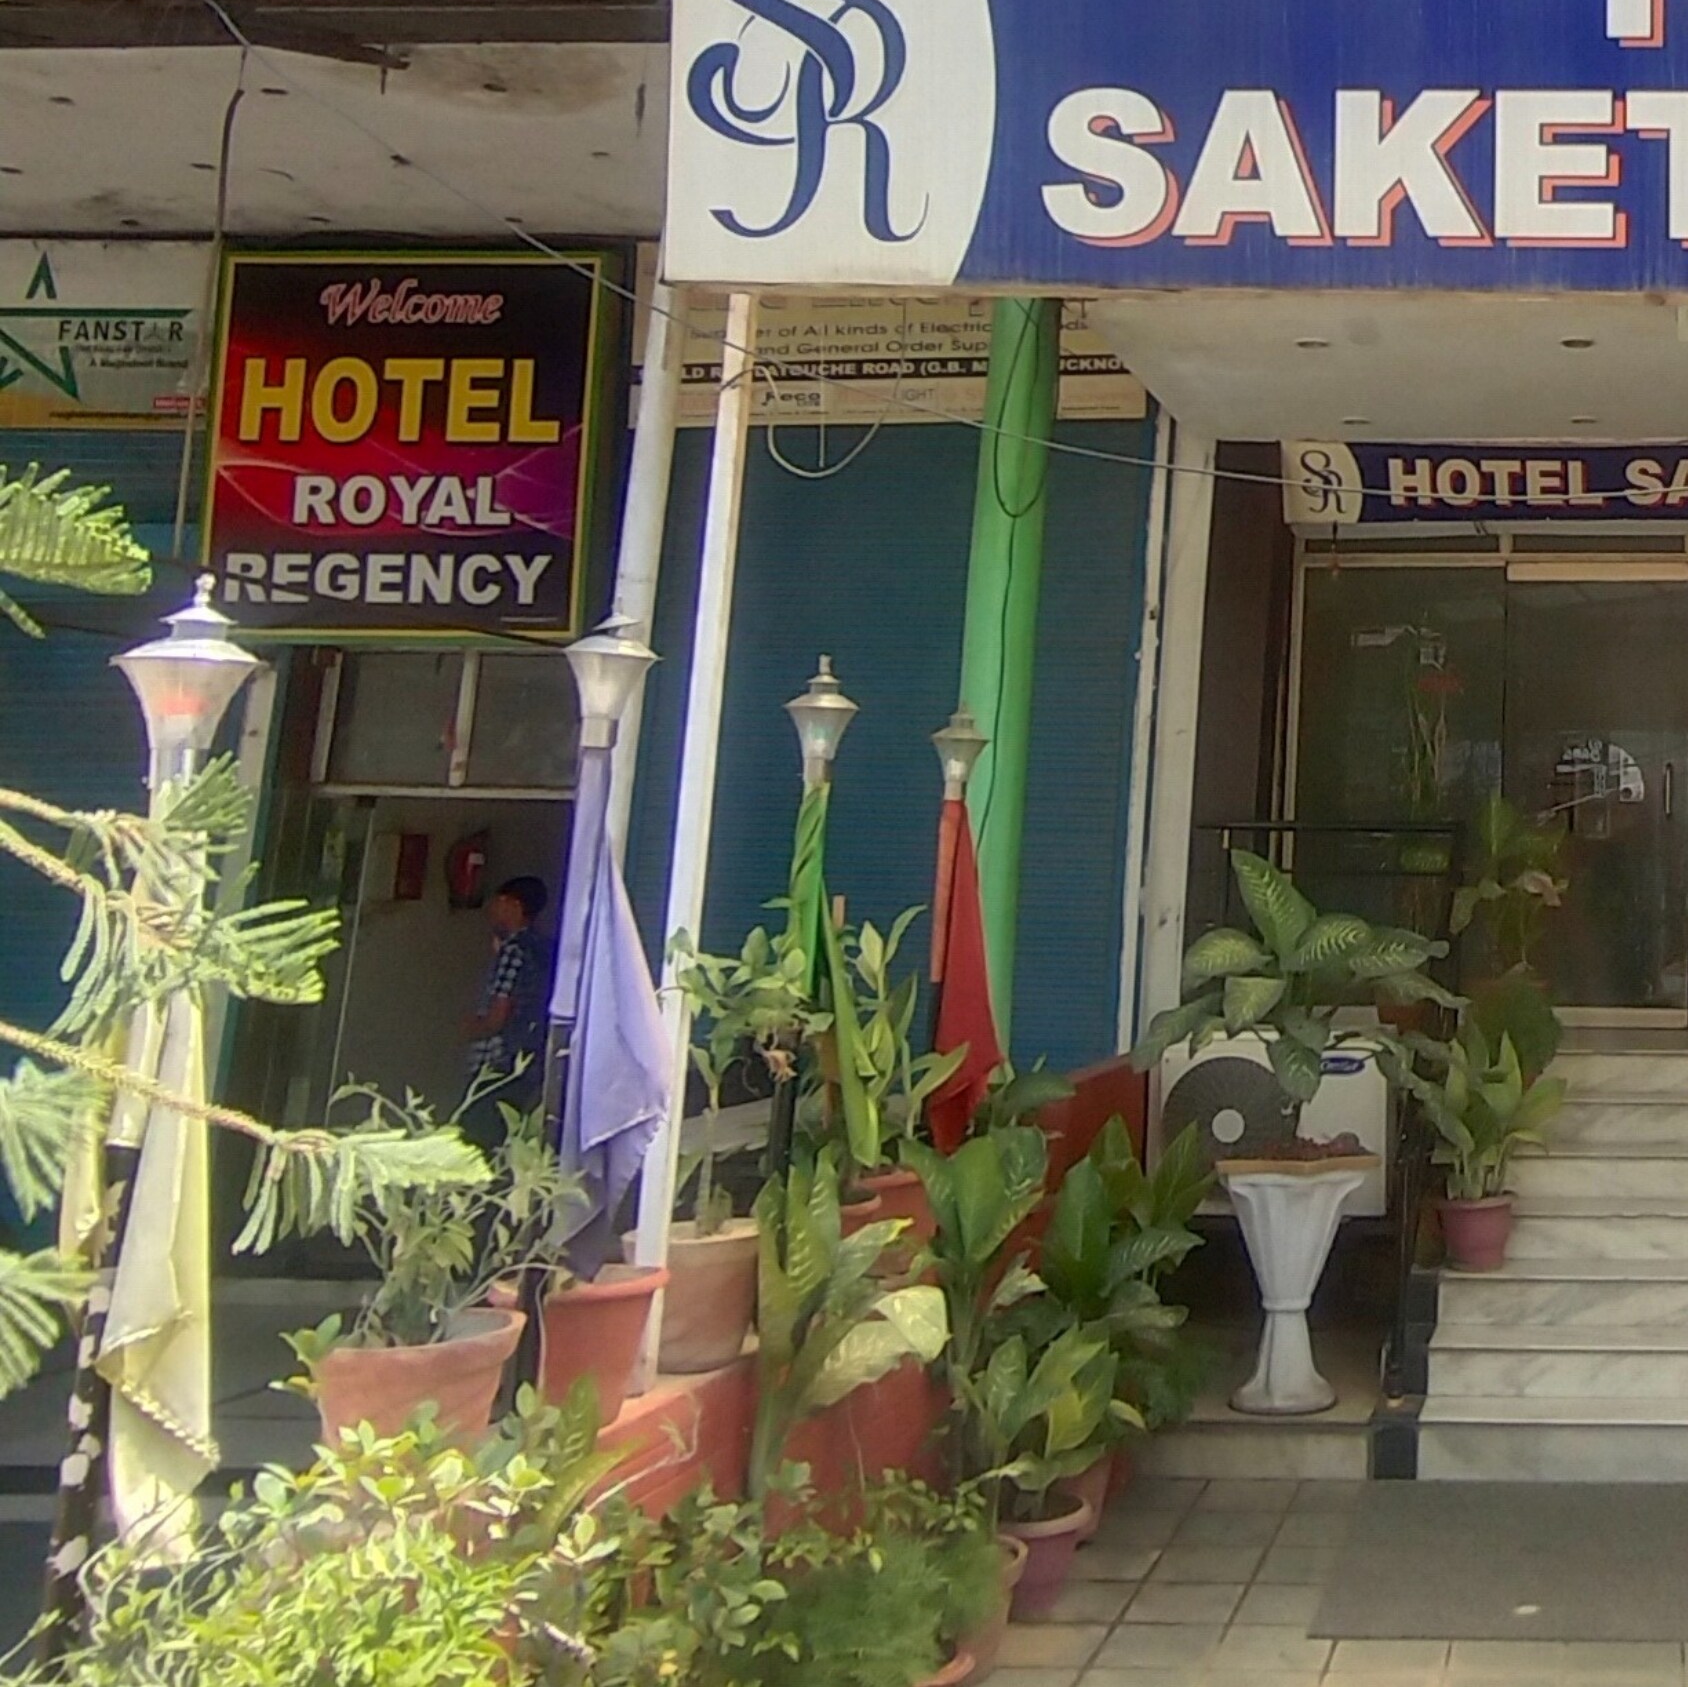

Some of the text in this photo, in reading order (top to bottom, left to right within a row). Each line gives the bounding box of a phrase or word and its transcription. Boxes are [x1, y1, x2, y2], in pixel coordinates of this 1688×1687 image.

[320, 278, 504, 327] Welcome
[778, 325, 797, 337] of
[836, 321, 888, 335] kinds
[796, 341, 880, 355] General
[886, 337, 943, 353] Order
[862, 360, 914, 375] ROAD
[238, 356, 560, 443] HOTEL
[292, 475, 511, 525] ROYAL
[1387, 457, 1603, 506] HOTEL
[223, 552, 552, 605] REGENCY
